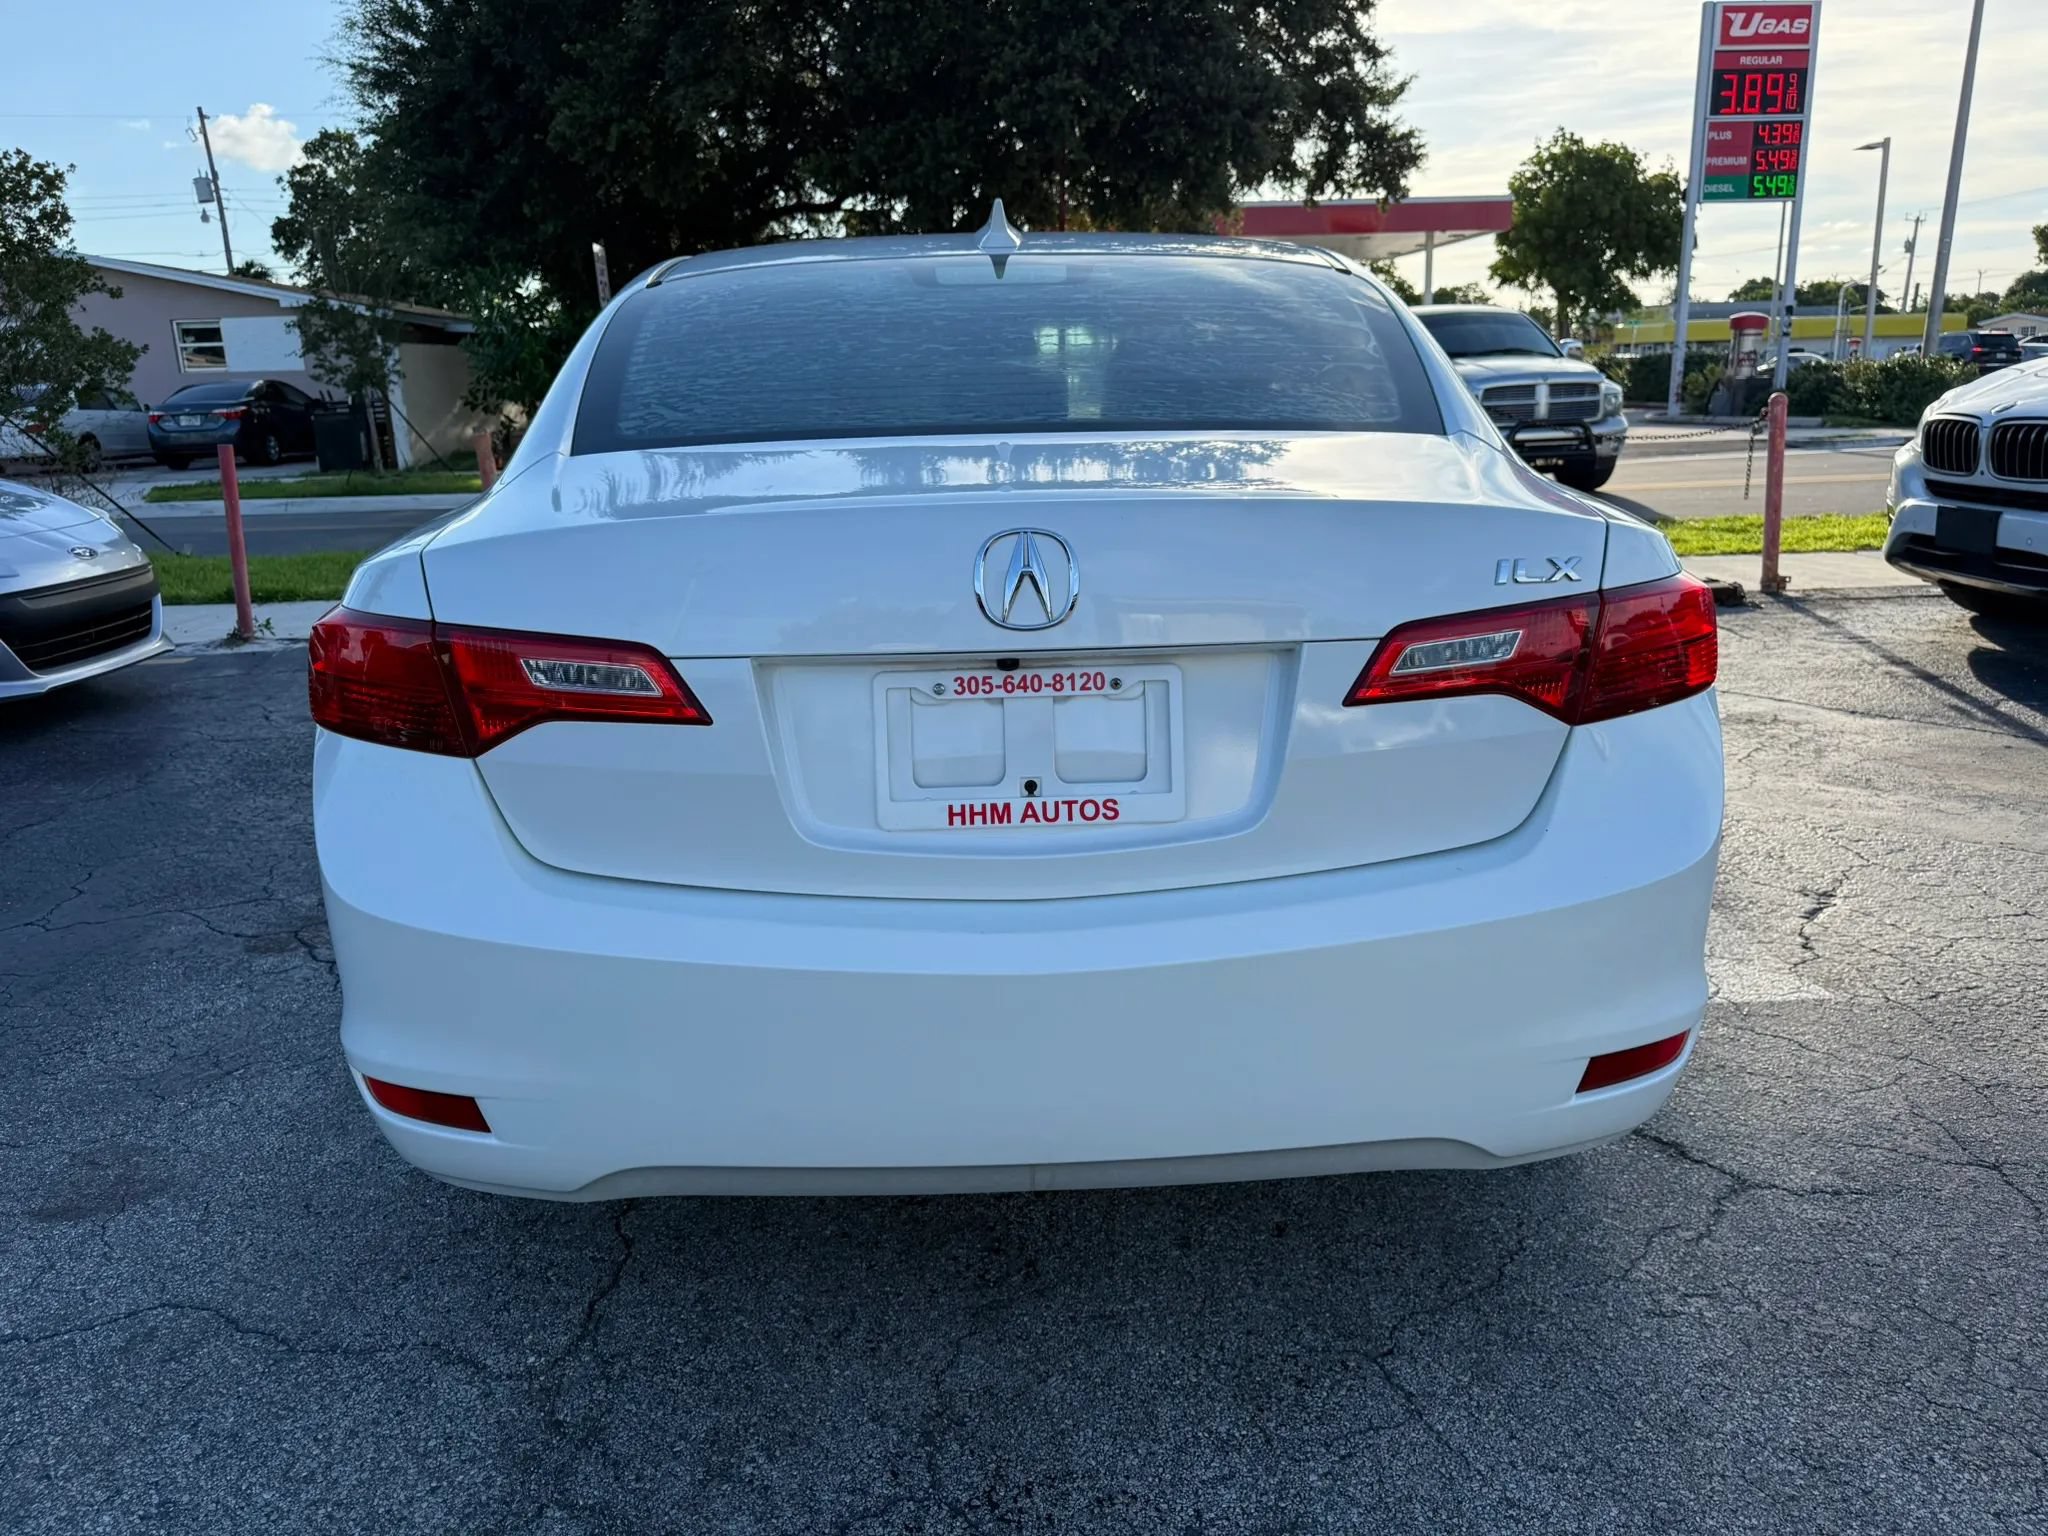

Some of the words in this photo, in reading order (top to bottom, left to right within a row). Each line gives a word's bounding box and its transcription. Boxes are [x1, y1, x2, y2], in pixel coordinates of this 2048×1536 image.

[1740, 56, 1783, 65] REGULAR
[1708, 130, 1732, 140] PLUS
[1706, 156, 1747, 166] PREMIUM
[1704, 183, 1735, 193] DIESEL
[1494, 556, 1582, 586] ILX
[953, 671, 1106, 696] 305-640-8120
[948, 802, 1012, 827] HHM
[1020, 799, 1120, 824] AUTOS
